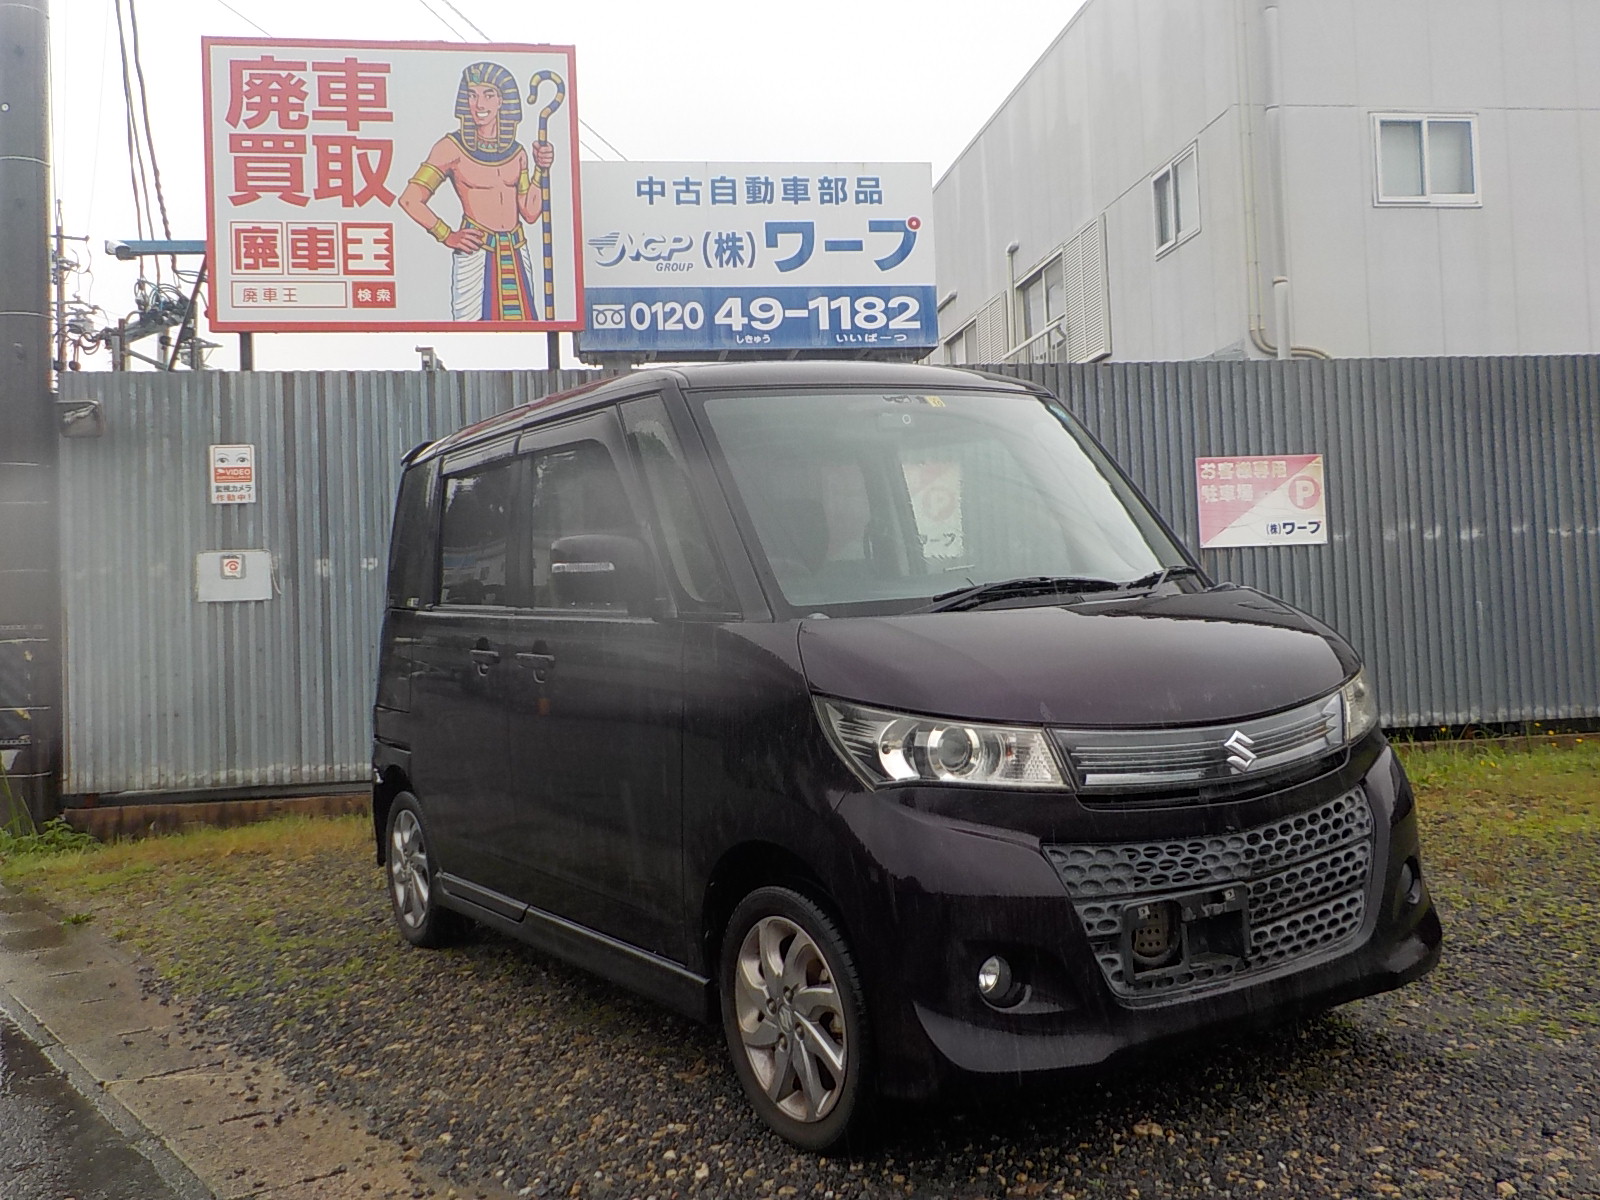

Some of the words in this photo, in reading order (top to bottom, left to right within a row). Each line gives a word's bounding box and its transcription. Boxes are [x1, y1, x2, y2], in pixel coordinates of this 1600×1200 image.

[225, 55, 394, 131] 廃車
[228, 133, 396, 208] 買取
[636, 175, 884, 206] 中古自動車部品
[230, 222, 395, 276] 廃車王
[655, 262, 694, 272] GROUP
[242, 287, 299, 302] 廃車王
[357, 288, 392, 302] 検索
[630, 301, 704, 331] 0120
[714, 295, 921, 331] 49-1182
[736, 335, 771, 344] しきゅう
[1295, 480, 1315, 506] P
